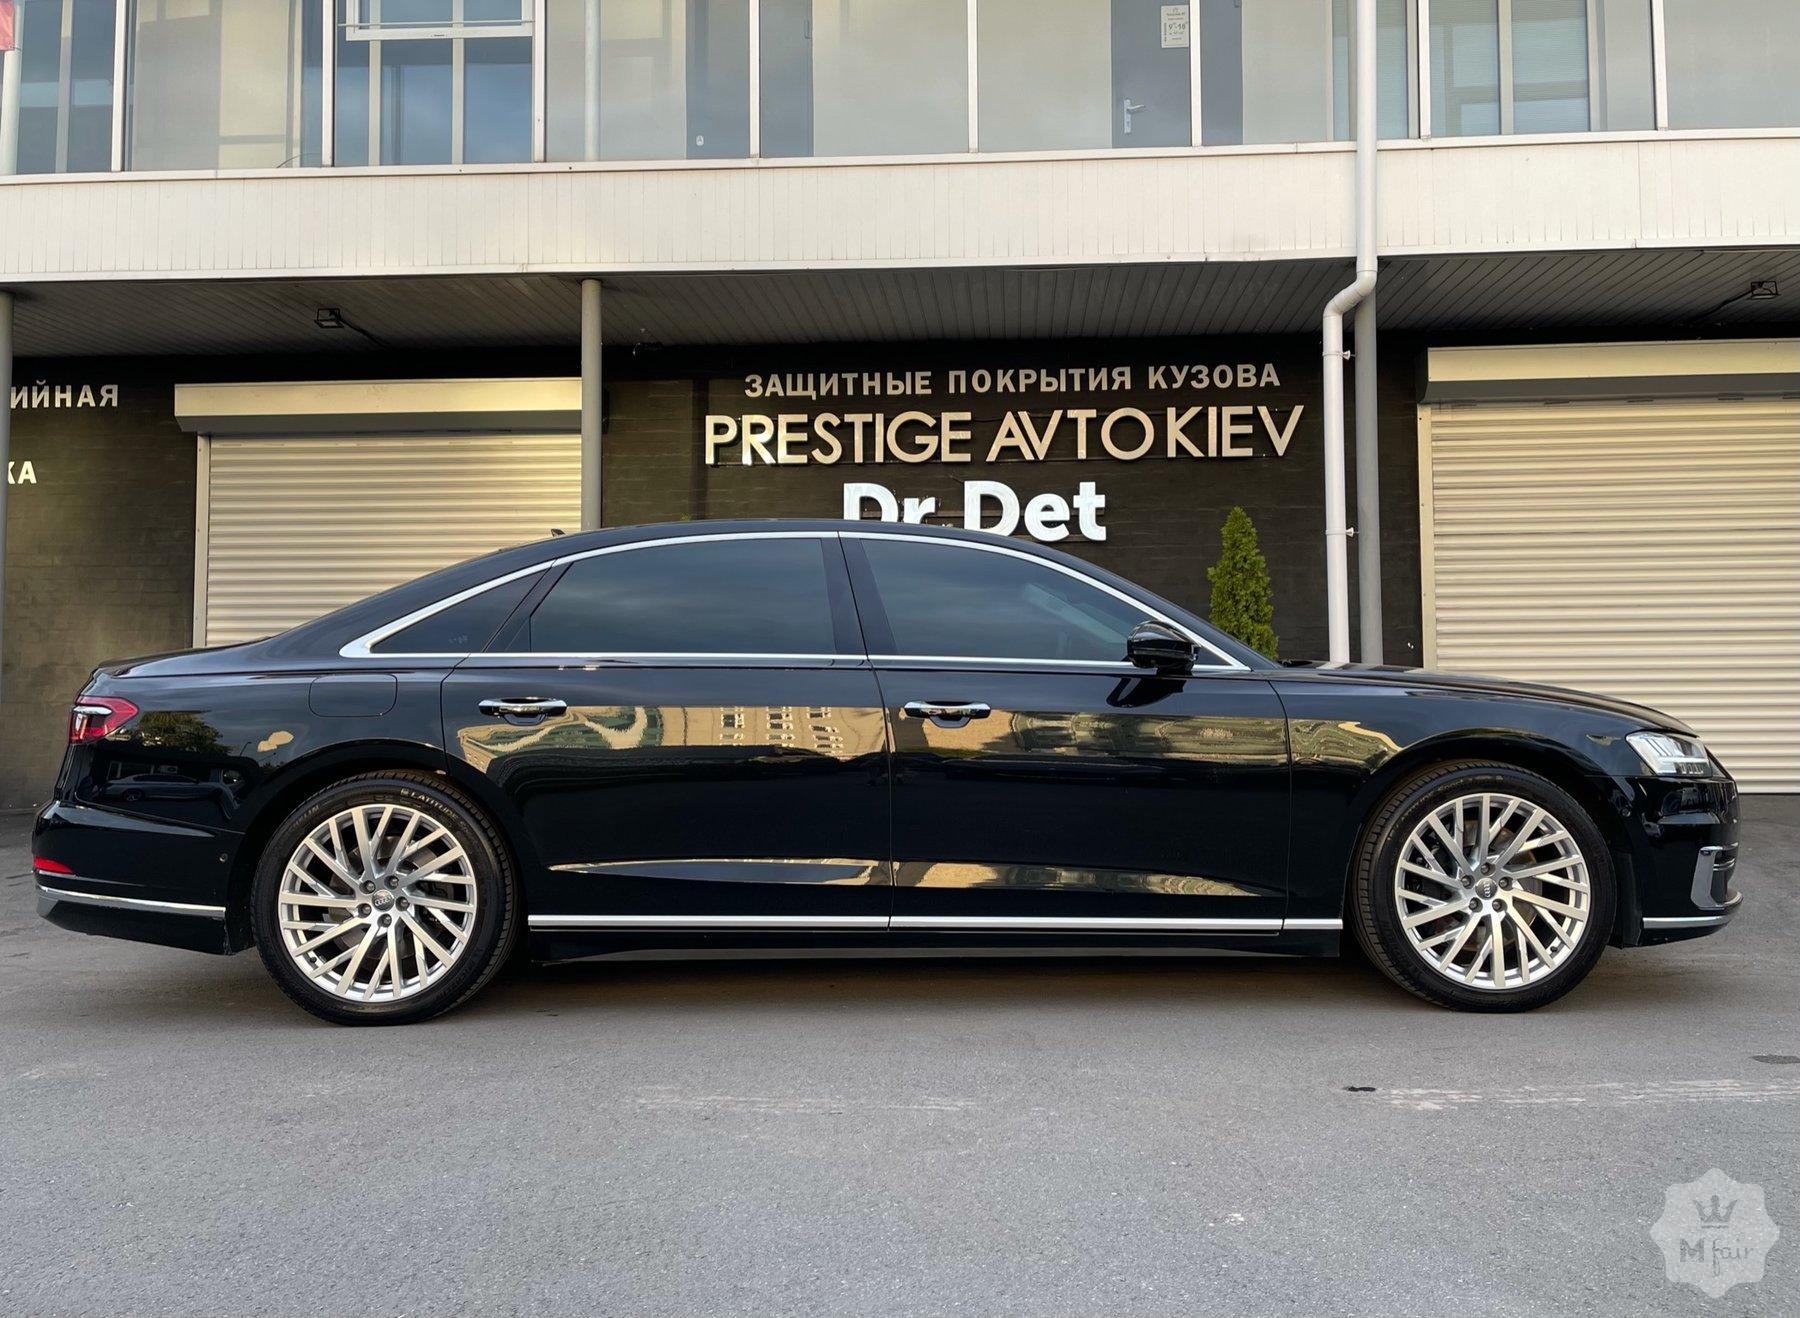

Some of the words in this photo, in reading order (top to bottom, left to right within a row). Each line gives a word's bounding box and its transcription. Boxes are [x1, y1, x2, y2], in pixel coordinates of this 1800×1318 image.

[744, 371, 932, 400] ЗАЩИТНЫЕ
[949, 366, 1132, 394] ПОКРЫТИЯ
[1148, 363, 1281, 390] КУЗОВА
[705, 410, 972, 465] PRESTIGE
[985, 407, 1155, 461] AVTO
[1166, 405, 1304, 457] KIEV
[963, 480, 1107, 542] Det
